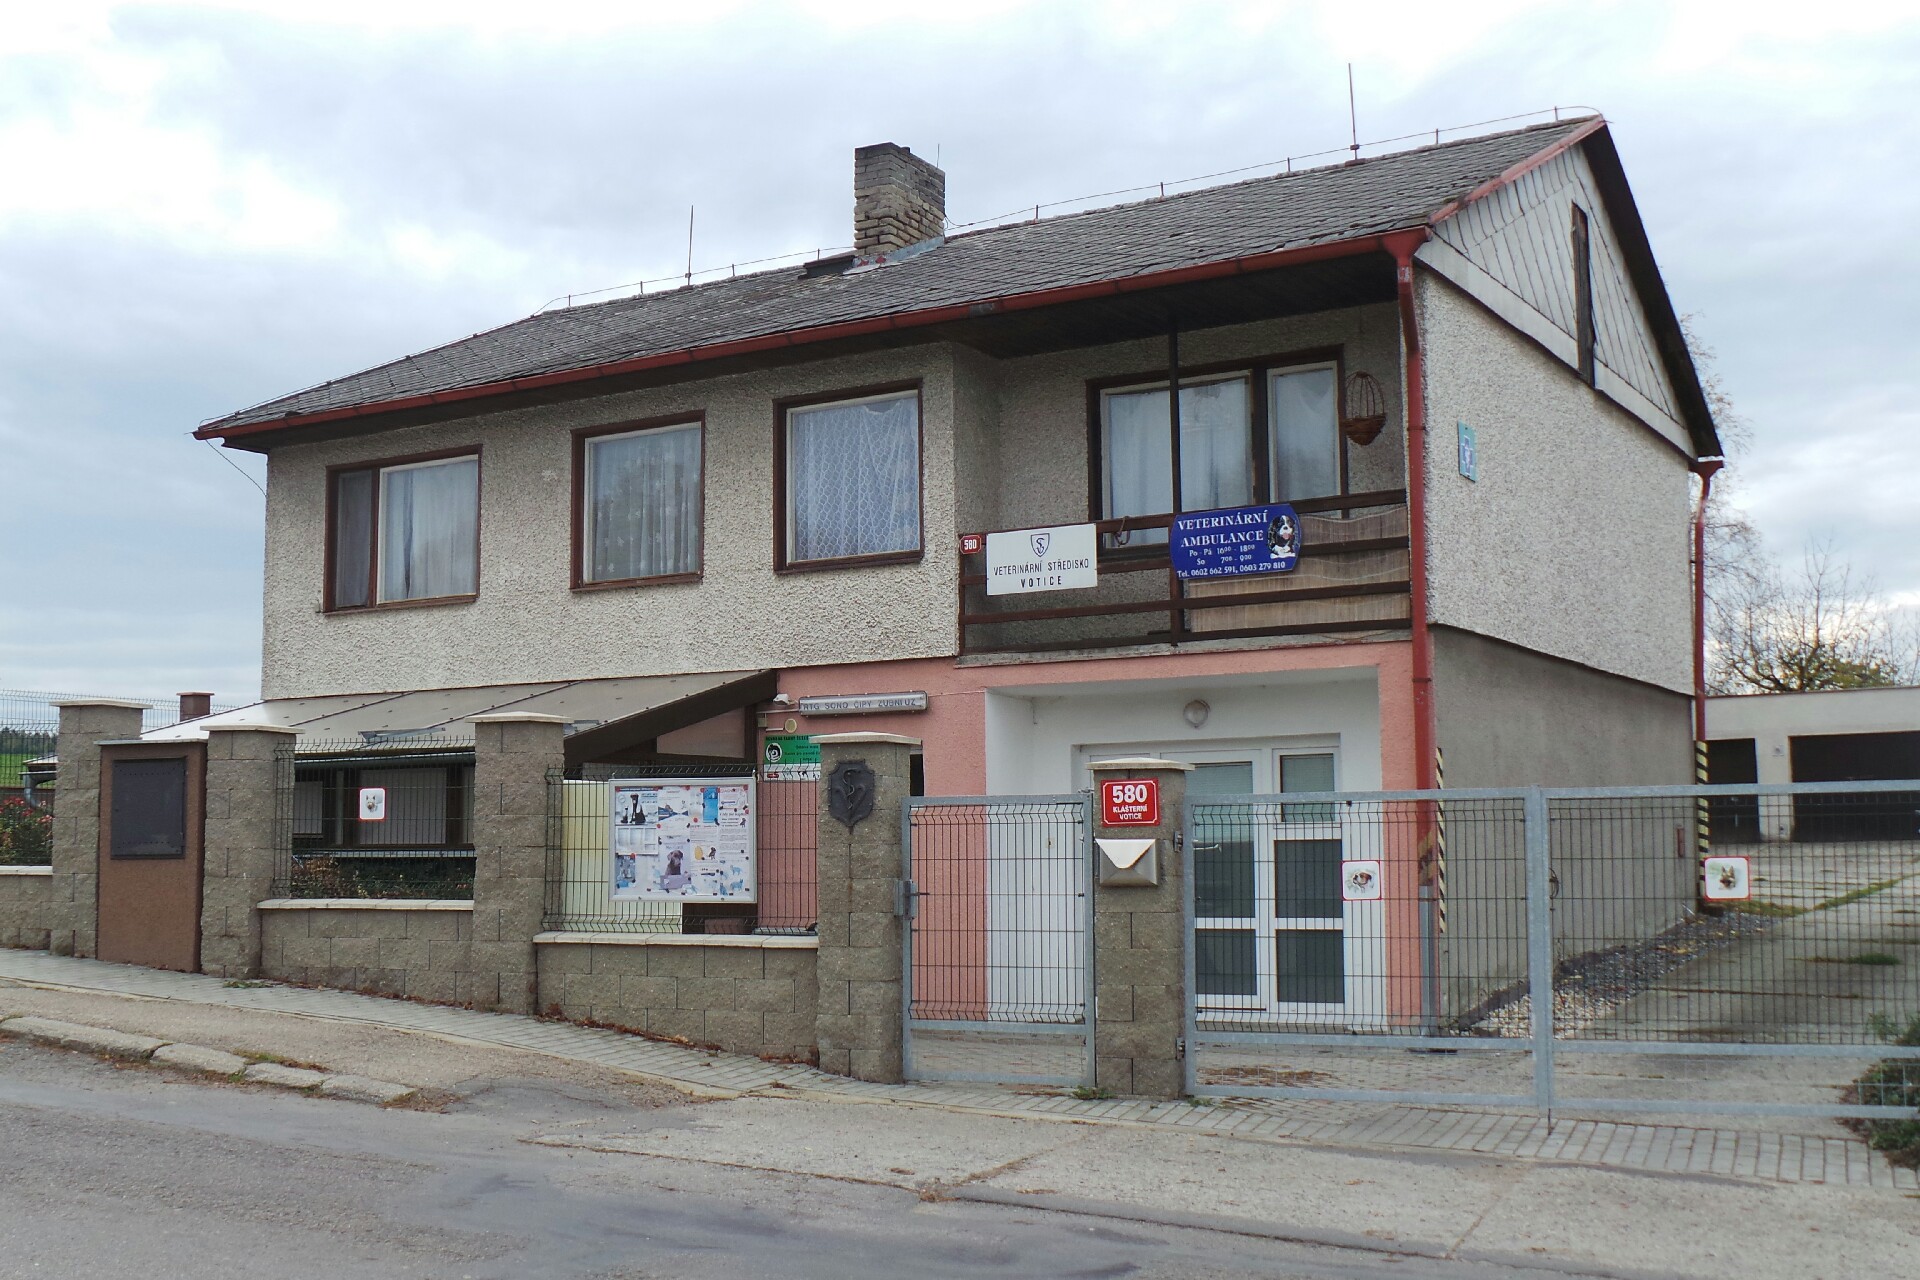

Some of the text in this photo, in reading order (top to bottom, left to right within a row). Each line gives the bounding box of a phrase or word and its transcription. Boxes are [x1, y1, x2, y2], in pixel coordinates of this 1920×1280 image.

[1178, 510, 1268, 530] VETERINÁRNÍ
[964, 539, 977, 550] 580
[1181, 530, 1264, 547] AMBULANCE
[994, 556, 1089, 576] VETERINÁRNÍ STŘEDISKO
[1177, 561, 1286, 578] Tel. 0602 662 591, 0603 279 810
[1021, 576, 1062, 588] VOTICE
[824, 702, 848, 710] SONO
[1112, 784, 1147, 804] 580
[1112, 804, 1148, 813] KLÁŠTERNÍ
